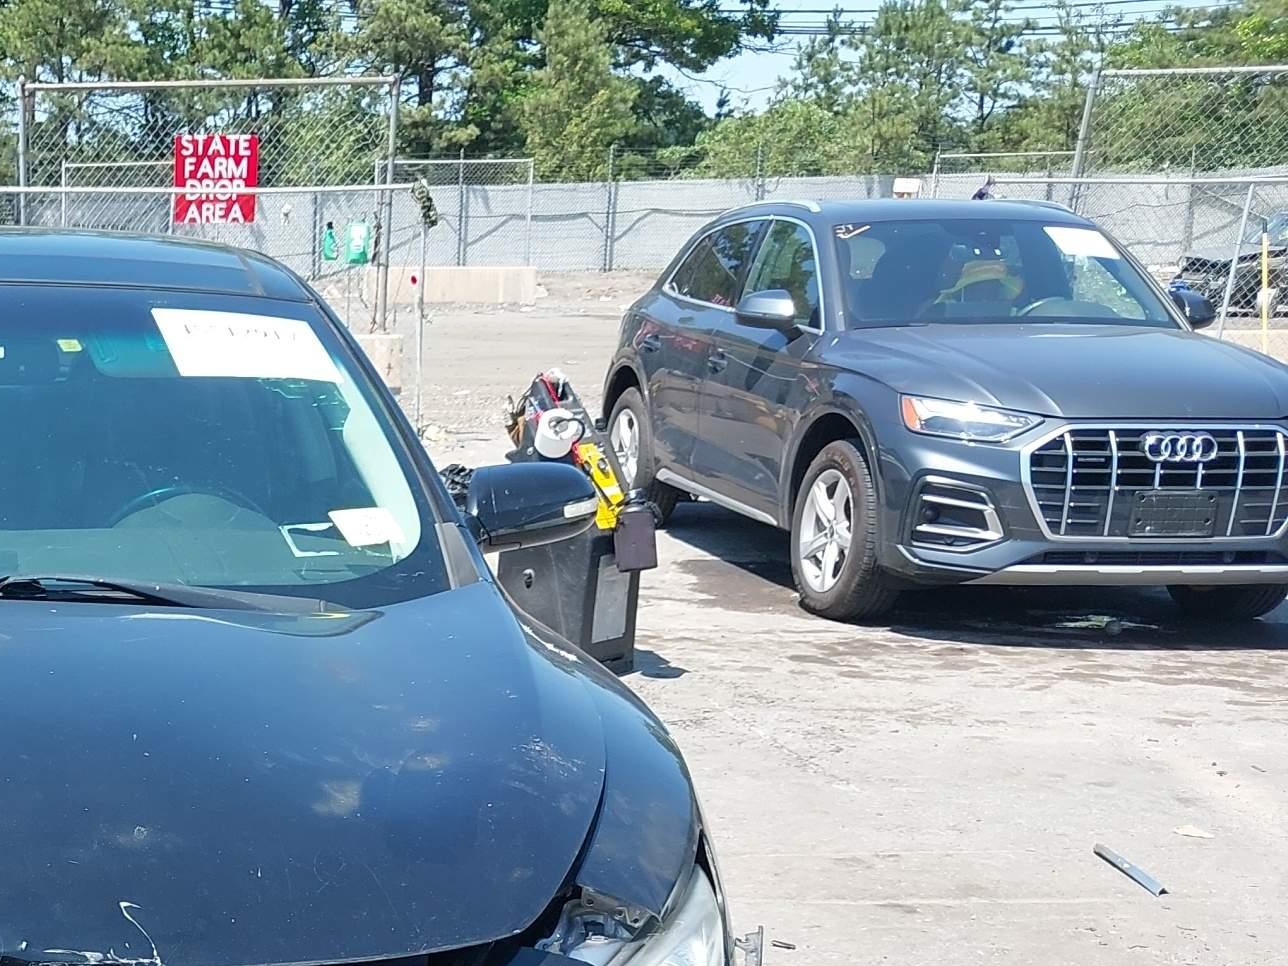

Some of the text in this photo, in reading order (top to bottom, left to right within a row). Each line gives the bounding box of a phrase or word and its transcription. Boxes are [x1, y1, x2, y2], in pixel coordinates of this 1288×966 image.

[180, 134, 252, 156] STATE
[183, 156, 249, 179] FARM
[185, 179, 246, 201] DROP
[183, 202, 245, 224] AREA
